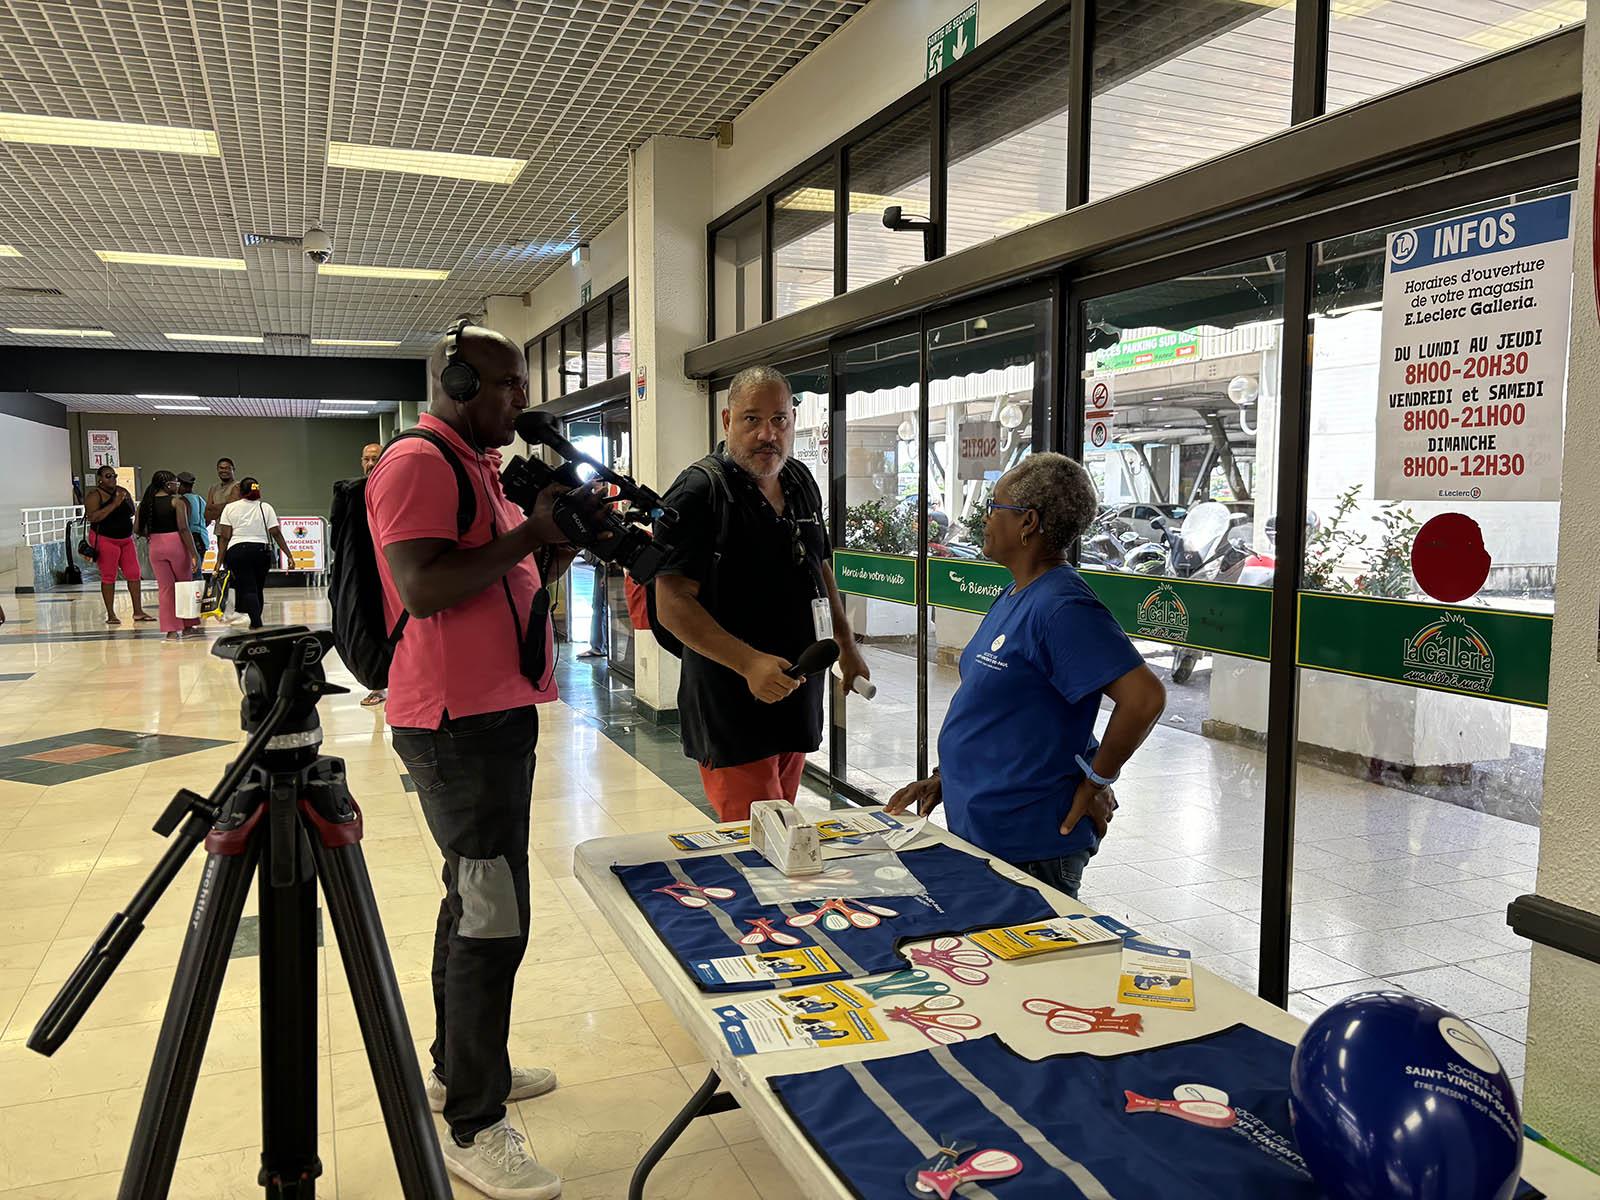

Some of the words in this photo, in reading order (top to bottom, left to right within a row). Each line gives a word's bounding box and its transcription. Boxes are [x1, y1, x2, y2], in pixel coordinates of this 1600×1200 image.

[1432, 212, 1517, 259] INFOS
[1404, 273, 1458, 295] Horaires
[1461, 258, 1545, 283] d'ouverture
[1411, 295, 1428, 309] de
[1430, 287, 1465, 304] votre
[1468, 277, 1534, 299] magasin
[1404, 306, 1467, 327] E.Leclerc
[1470, 295, 1537, 317] Galleria.
[1122, 339, 1158, 355] PARKING
[1159, 334, 1177, 348] SUD
[1394, 346, 1412, 363] DU
[1418, 339, 1460, 360] LUNDI
[1469, 335, 1488, 355] AU
[1496, 329, 1544, 352] JEUDI
[1405, 352, 1530, 387] 8H00-20H30
[1389, 388, 1453, 409] VENDREDI
[1461, 386, 1479, 403] et
[1489, 380, 1545, 402] SAMEDI
[1403, 403, 1526, 433] 8H00-21H00
[1428, 435, 1498, 454] DIMANCHE
[1403, 454, 1525, 479] 8H00-12H30
[1438, 490, 1470, 500] E.Leclerc
[572, 513, 587, 533] SONY
[841, 565, 859, 578] Merci
[860, 571, 869, 579] de
[868, 571, 886, 583] votre
[885, 572, 906, 585] visite
[960, 579, 967, 592] à
[1148, 600, 1189, 627] Galleria
[1403, 638, 1420, 662] la
[1421, 635, 1494, 674] Galleria
[192, 860, 216, 930] sachtler
[1272, 1135, 1293, 1147] DE
